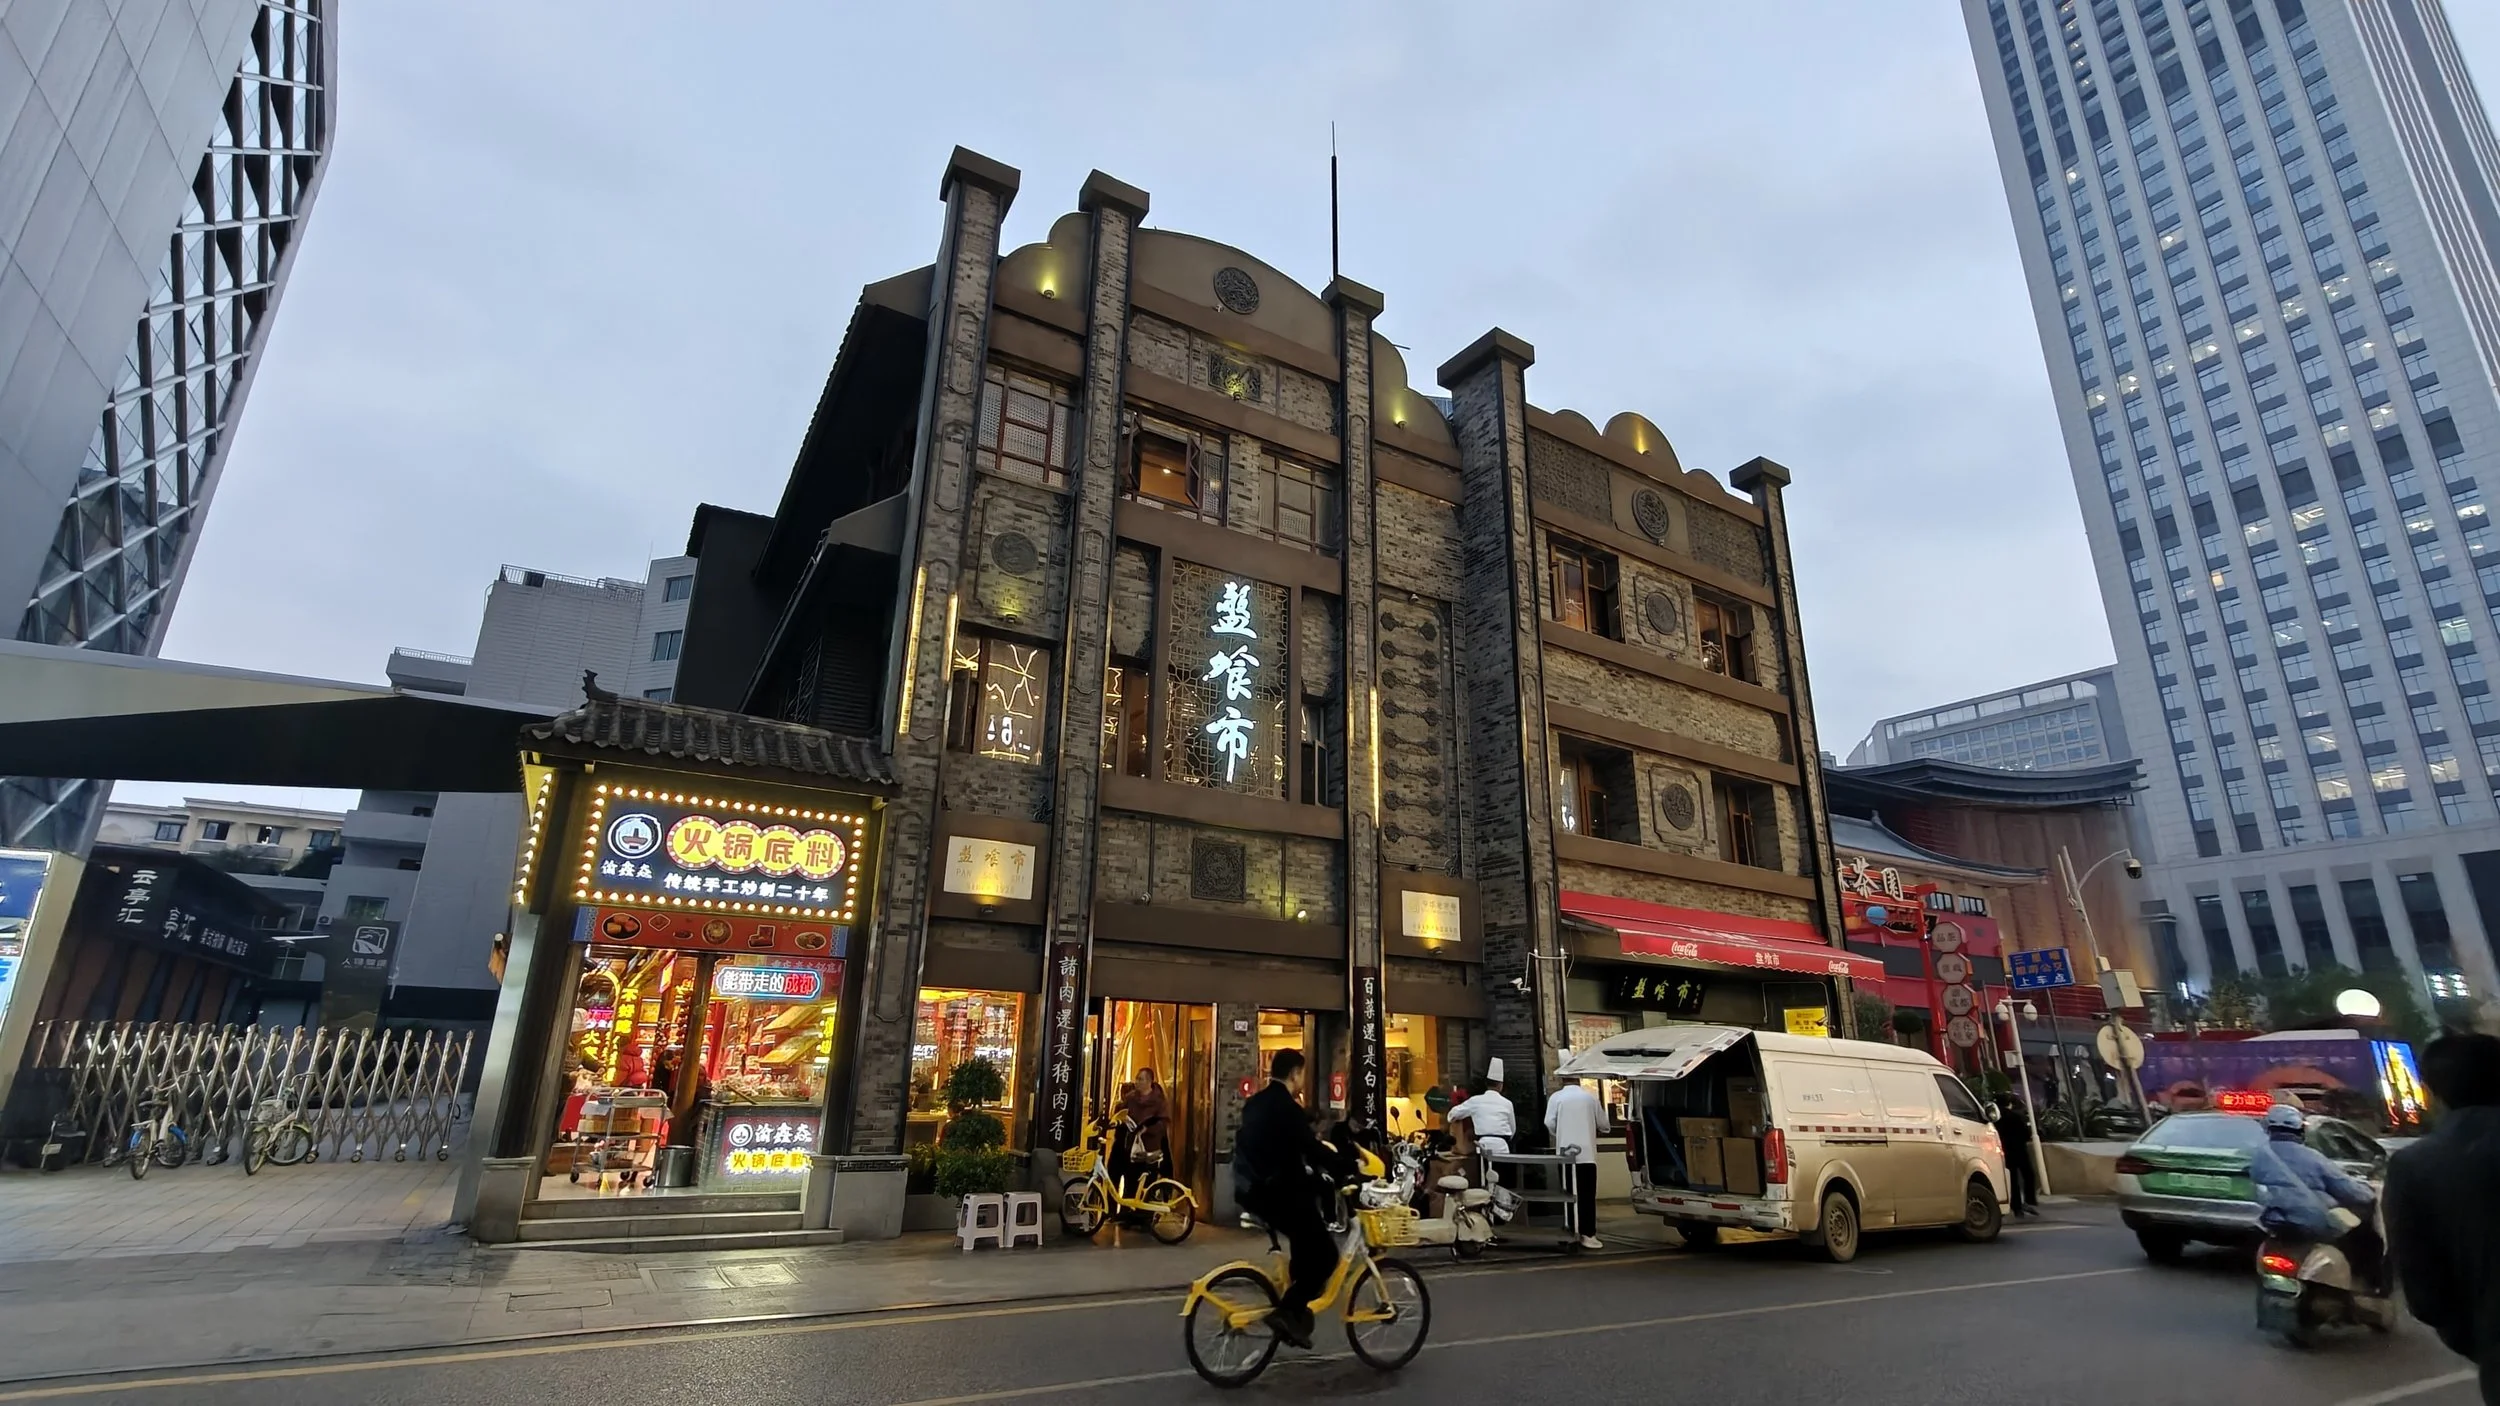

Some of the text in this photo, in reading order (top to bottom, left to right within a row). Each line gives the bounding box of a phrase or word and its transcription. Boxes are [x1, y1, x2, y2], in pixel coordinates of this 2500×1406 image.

[680, 827, 835, 869] 火锅底料
[116, 869, 158, 924] 云亭汇
[663, 872, 830, 902] 传统手工炒制二十年
[722, 969, 817, 996] 能带走的成都
[2019, 973, 2066, 987] 上车点
